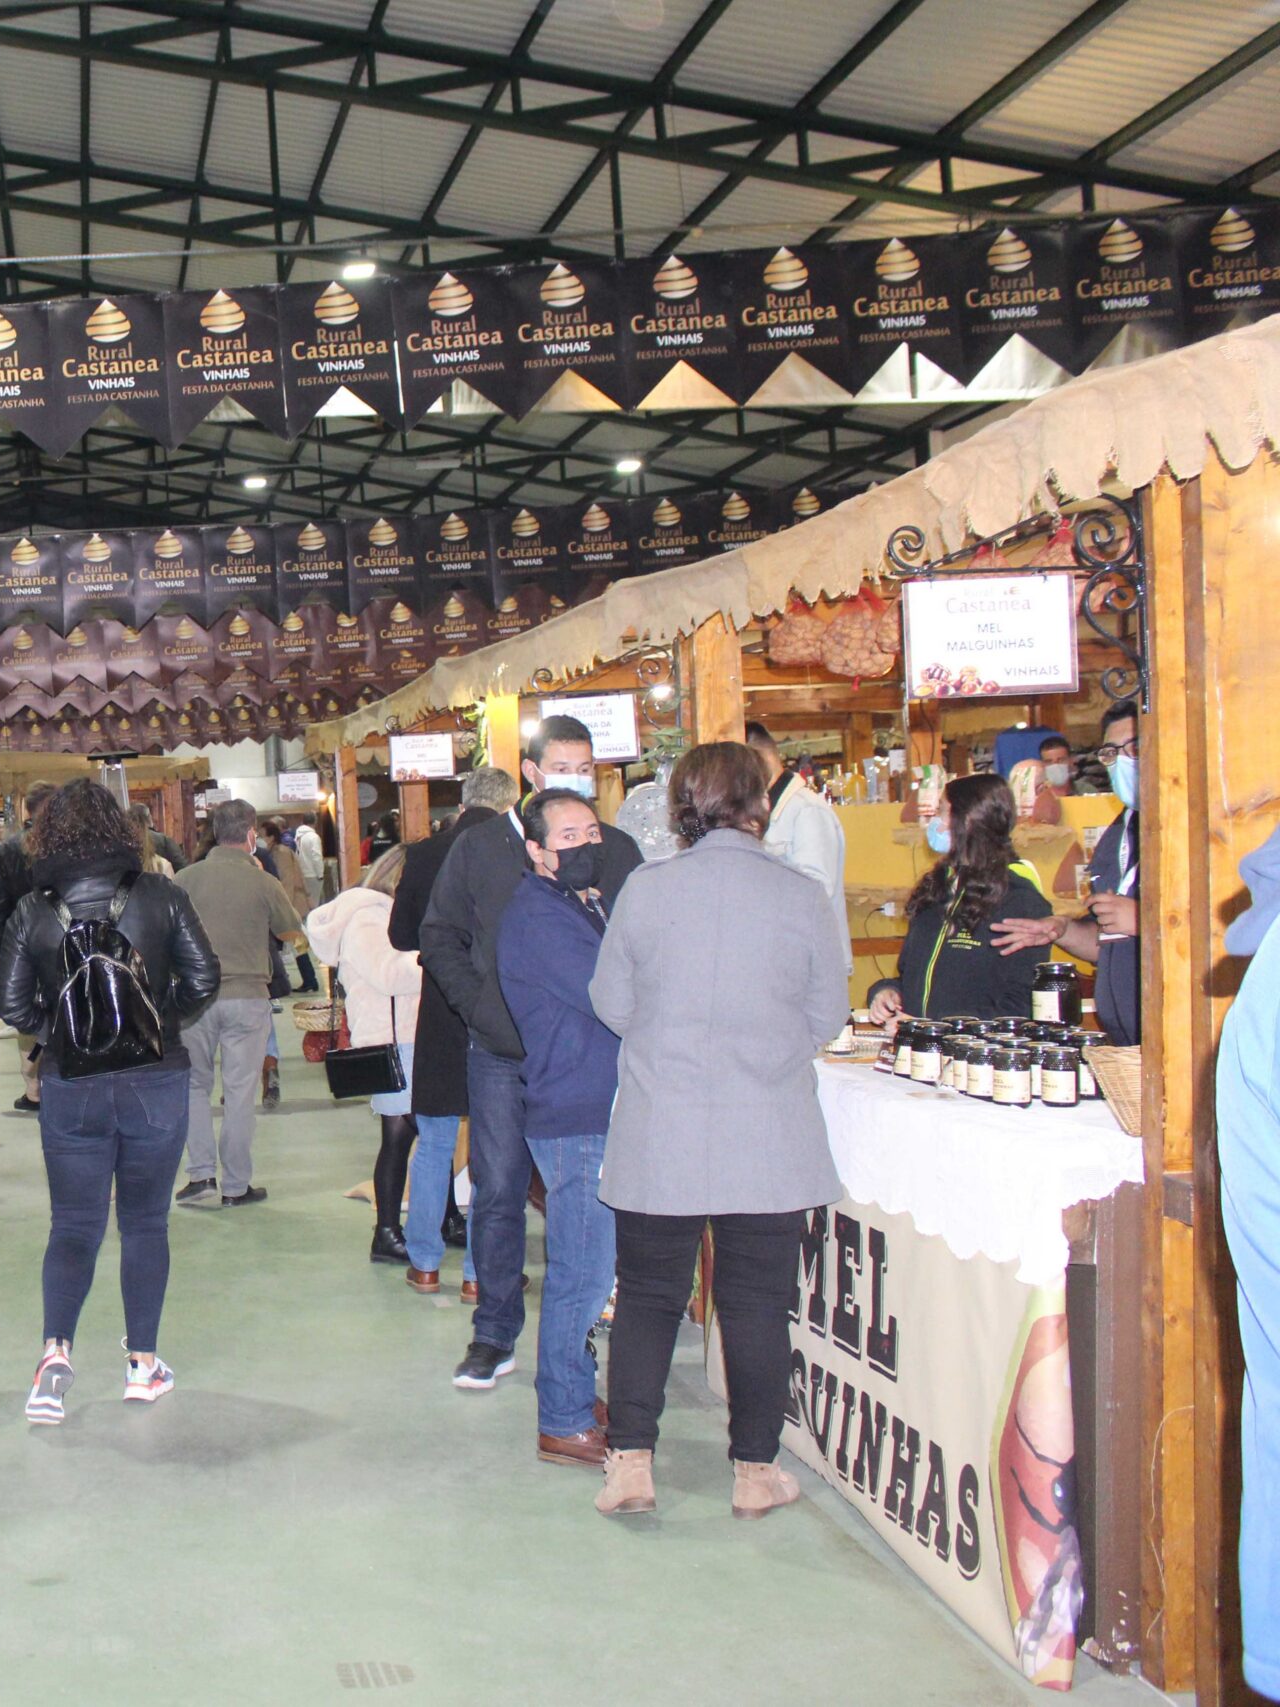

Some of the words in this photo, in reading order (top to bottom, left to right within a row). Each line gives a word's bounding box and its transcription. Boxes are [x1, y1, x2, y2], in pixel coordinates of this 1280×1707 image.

[1101, 261, 1146, 281] Rural
[1188, 266, 1280, 288] Castanea
[990, 271, 1034, 290] Rural
[1076, 275, 1172, 298] Castanea
[878, 281, 922, 299] Rural
[965, 286, 1060, 308] Castanea
[1213, 285, 1262, 299] VINHAIS
[766, 289, 811, 309] Rural
[853, 295, 949, 317] Castanea
[1102, 296, 1149, 310] VINHAIS
[655, 298, 700, 317] Rural
[991, 305, 1037, 319] VINHAIS
[542, 306, 587, 325] Rural
[741, 304, 837, 326] Castanea
[879, 315, 925, 328] VINHAIS
[431, 315, 476, 334] Rural
[630, 313, 727, 334] Castanea
[316, 324, 362, 343] Rural
[517, 321, 614, 343] Castanea
[767, 324, 814, 338] VINHAIS
[202, 333, 247, 351] Rural
[406, 329, 503, 352] Castanea
[656, 333, 703, 346] VINHAIS
[87, 342, 132, 360] Rural
[291, 339, 388, 360] Castanea
[543, 341, 590, 354] VINHAIS
[176, 348, 273, 368] Castanea
[433, 349, 479, 364] VINHAIS
[61, 357, 159, 377] Castanea
[317, 359, 364, 372] VINHAIS
[413, 367, 439, 378] FESTA
[441, 366, 455, 375] DA
[457, 362, 504, 374] CASTANHA
[202, 368, 249, 381] VINHAIS
[87, 377, 134, 390] VINHAIS
[182, 384, 209, 394] FESTA
[210, 383, 225, 393] DA
[226, 381, 273, 392] CASTANHA
[67, 393, 94, 403] FESTA
[95, 392, 110, 401] DA
[111, 389, 159, 401] CASTANHA
[369, 545, 398, 557] Rural
[567, 540, 628, 554] Castanea
[226, 553, 255, 565] Rural
[353, 555, 414, 568] Castanea
[583, 552, 613, 561] VINHAIS
[11, 565, 40, 577] Rural
[210, 563, 271, 576] Castanea
[369, 567, 399, 575] VINHAIS
[226, 575, 256, 584] VINHAIS
[11, 587, 41, 595] VINHAIS
[946, 597, 1031, 614] Castanea
[977, 623, 1002, 633] MEL
[946, 637, 1035, 651] MALGUINHAS
[1003, 665, 1060, 676] VINHAIS
